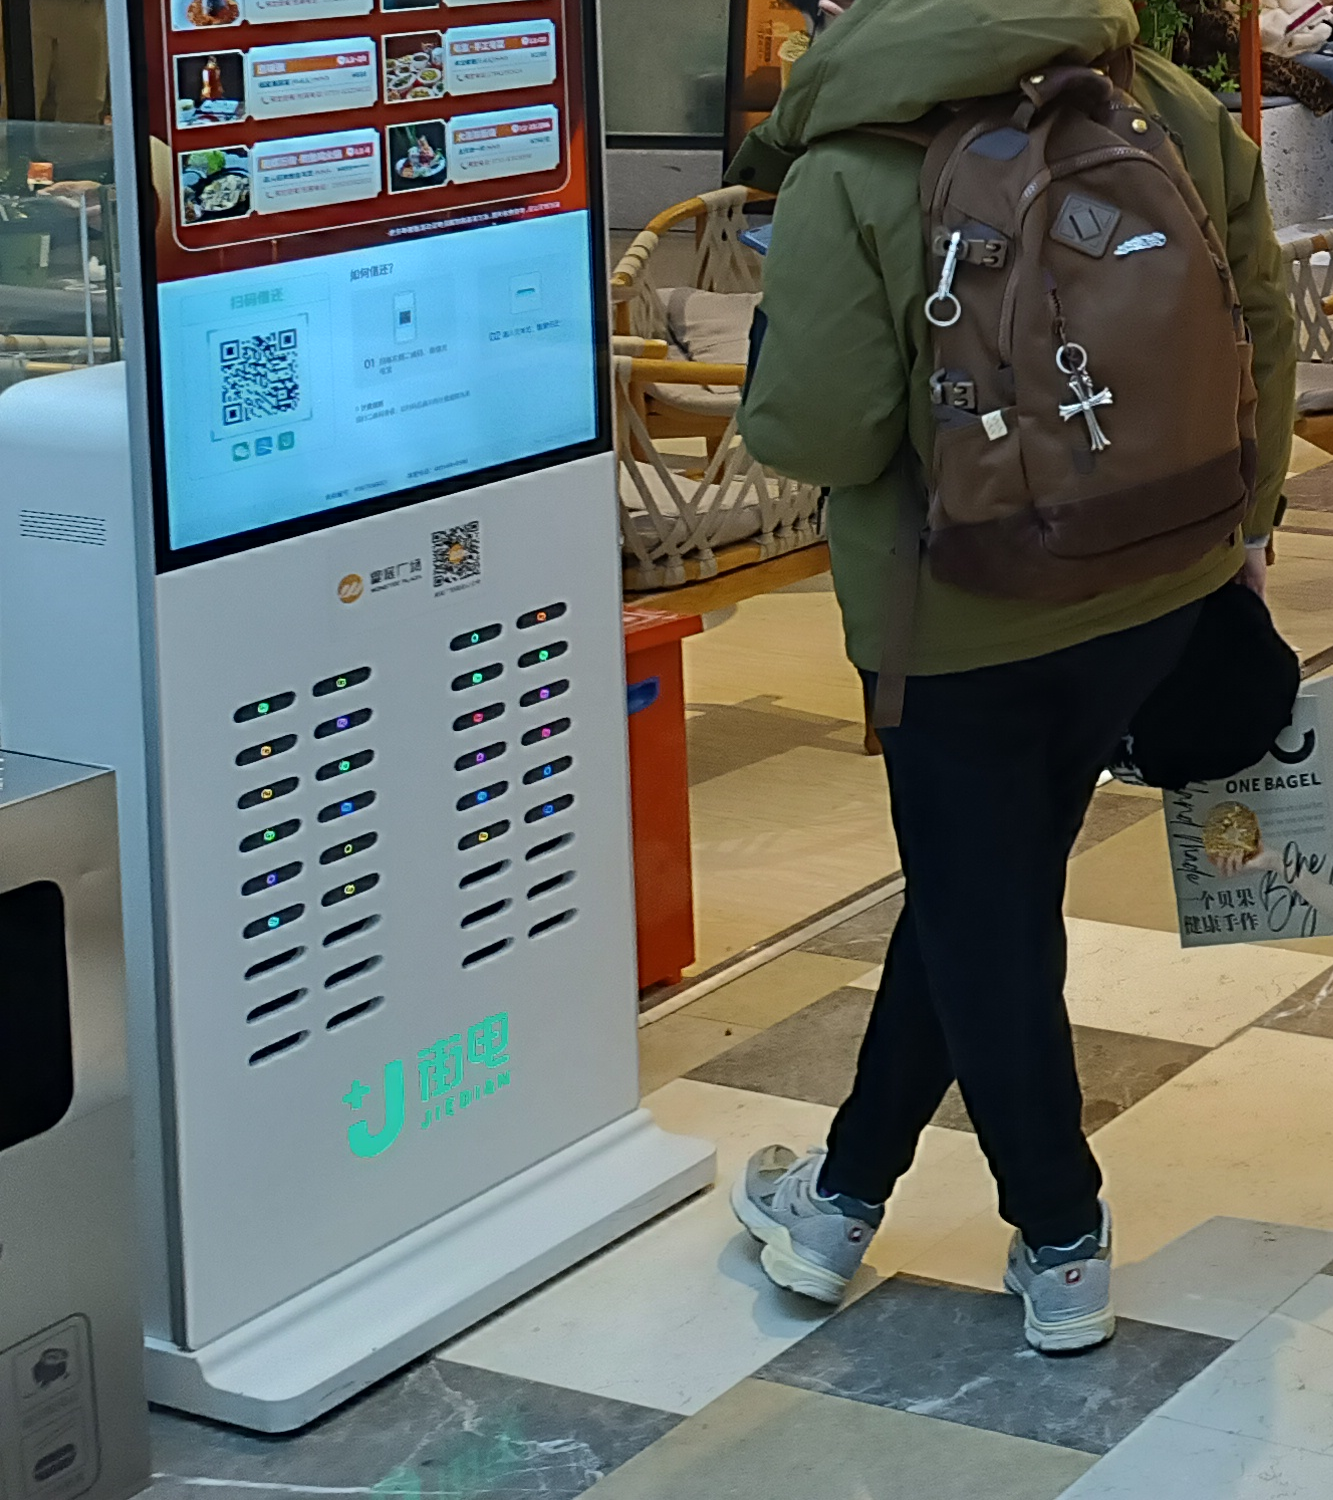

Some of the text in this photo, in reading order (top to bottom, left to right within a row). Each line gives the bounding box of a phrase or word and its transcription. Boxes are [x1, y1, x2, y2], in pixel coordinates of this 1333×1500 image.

[1225, 772, 1322, 794] ONE BAGEL
[417, 1011, 511, 1102] 街电
[420, 1070, 511, 1130] JIEDIAN
